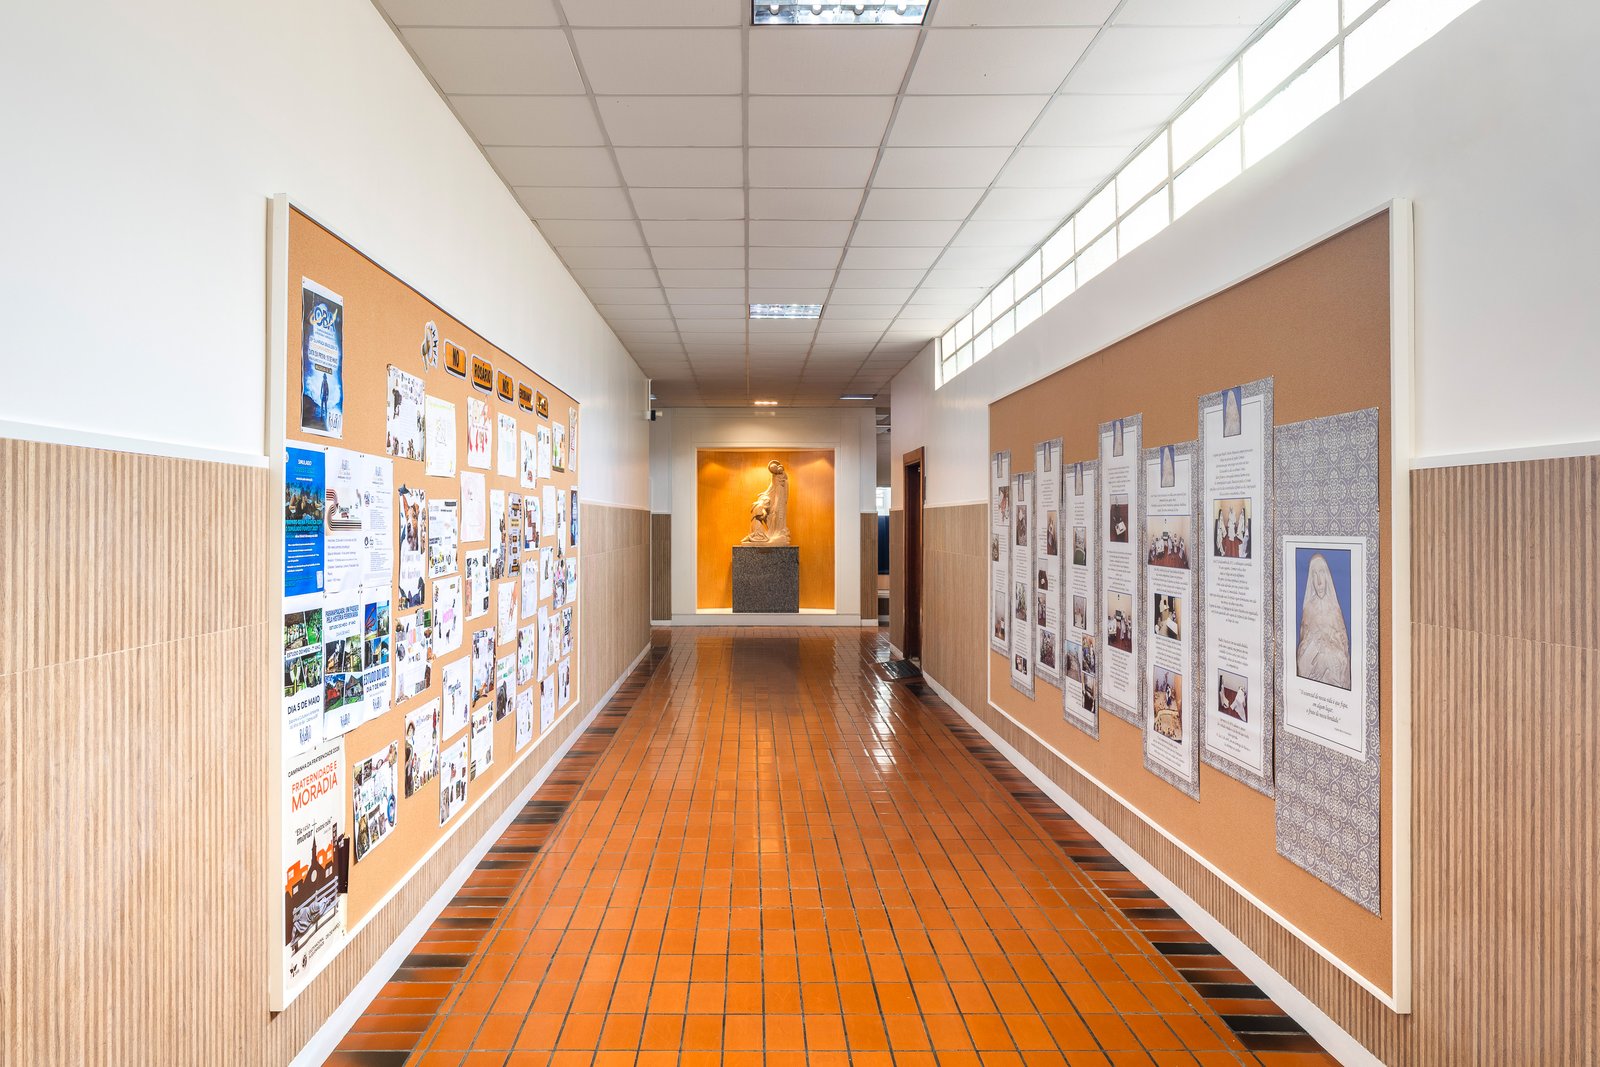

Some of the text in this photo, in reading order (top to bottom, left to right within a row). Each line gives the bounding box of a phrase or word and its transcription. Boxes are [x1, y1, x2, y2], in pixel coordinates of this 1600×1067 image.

[452, 347, 459, 367] NO
[288, 705, 297, 715] DIA
[301, 701, 307, 709] DE
[308, 695, 321, 707] MAIO
[288, 764, 306, 778] CAMPANHA
[311, 749, 332, 764] FRATERNIDADE
[291, 760, 337, 793] FRATERNIDADE E
[291, 771, 337, 812] MORADIA
